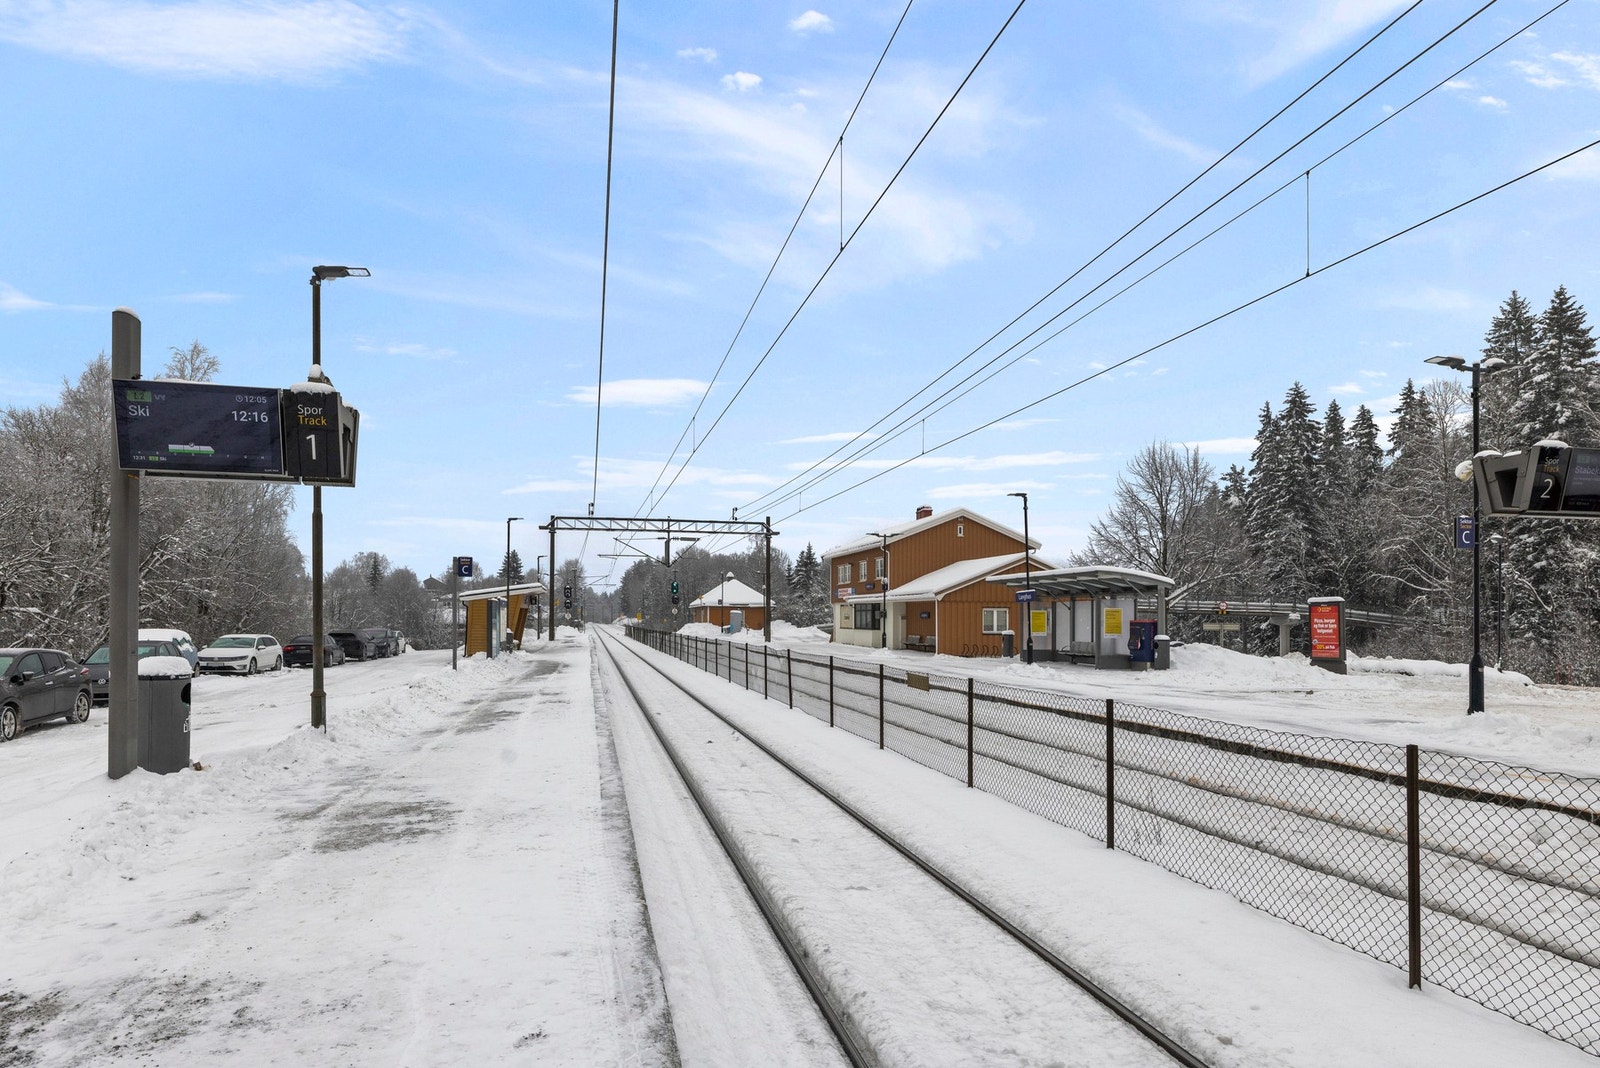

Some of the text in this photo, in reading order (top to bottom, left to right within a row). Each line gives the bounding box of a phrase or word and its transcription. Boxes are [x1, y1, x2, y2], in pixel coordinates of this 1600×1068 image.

[244, 394, 267, 404] 12:05
[128, 404, 150, 417] Ski
[297, 404, 322, 416] Spor
[231, 410, 269, 423] 12:16
[299, 415, 327, 426] Track
[306, 434, 316, 460] 1
[1545, 456, 1559, 465] Spor
[1543, 464, 1559, 473] Track
[1574, 465, 1600, 474] Stabek
[1540, 478, 1552, 498] 2
[1462, 530, 1470, 544] C
[462, 565, 469, 574] C
